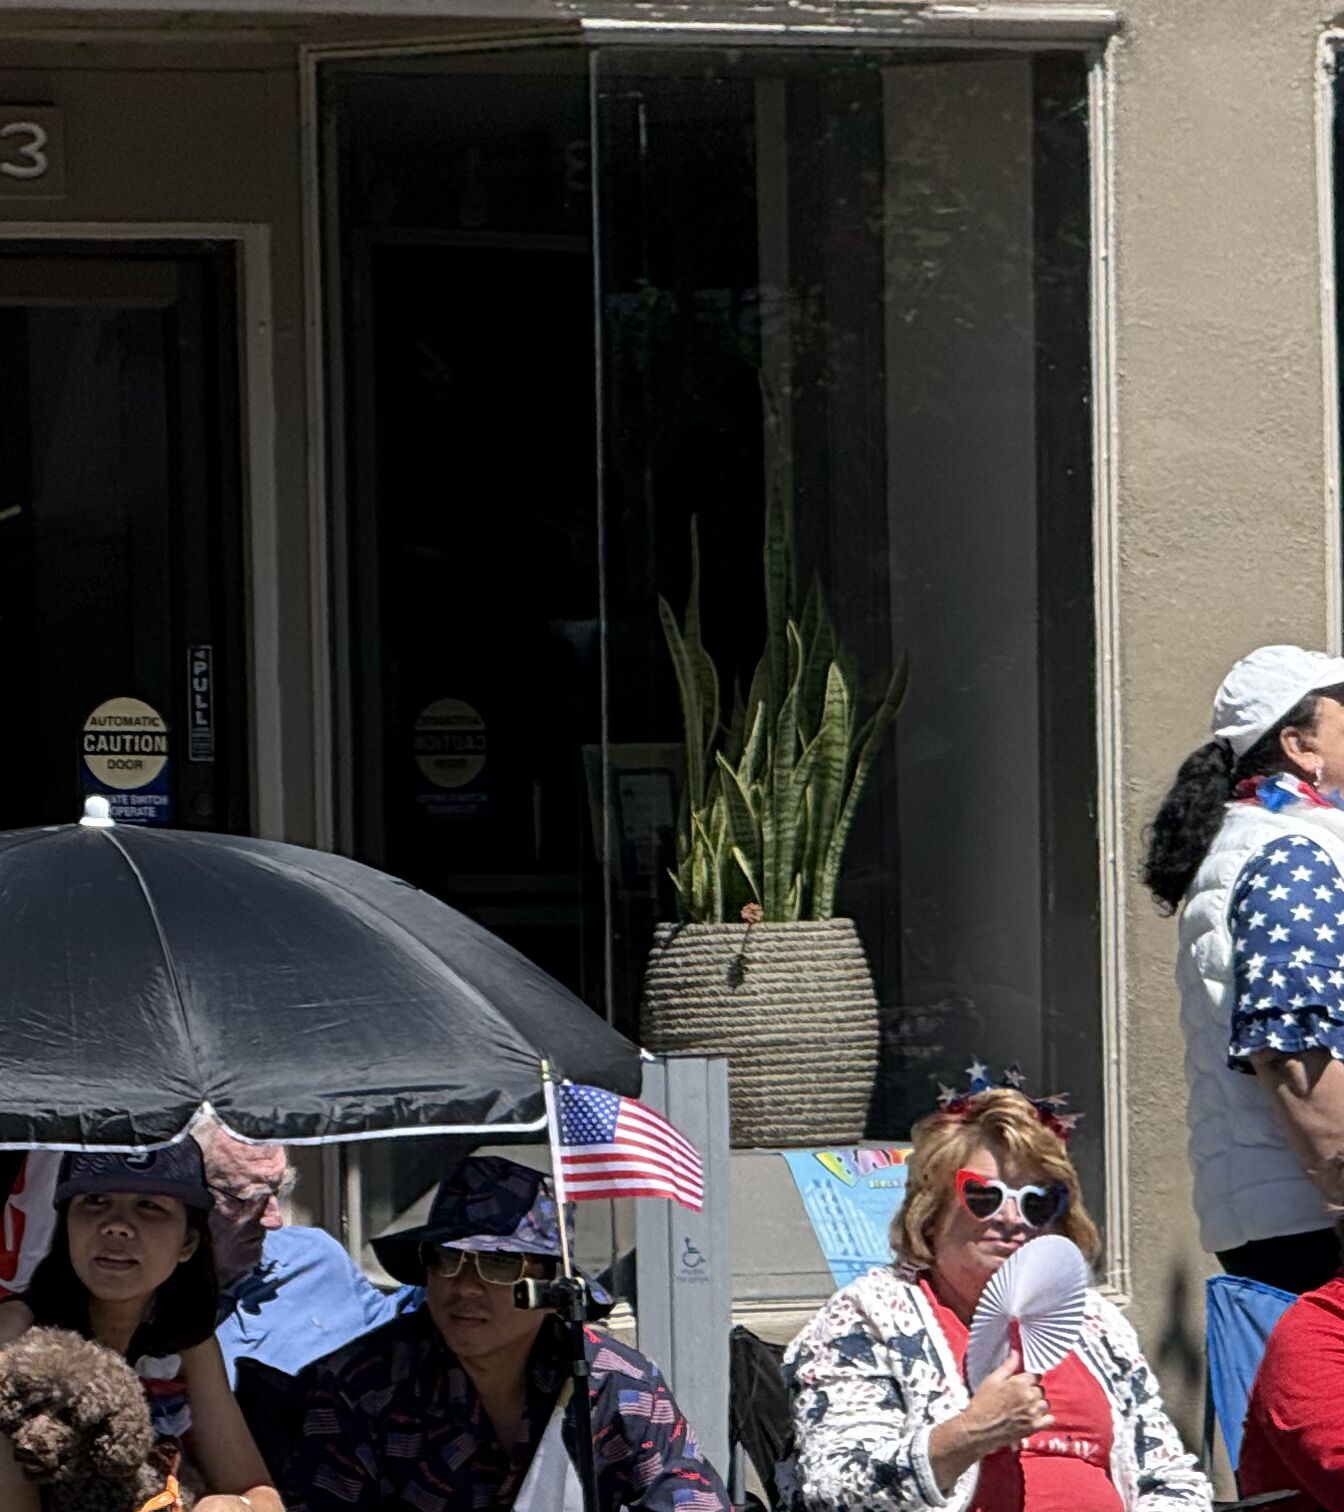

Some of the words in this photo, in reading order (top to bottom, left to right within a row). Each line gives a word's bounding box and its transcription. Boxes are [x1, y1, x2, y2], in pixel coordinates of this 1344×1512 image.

[0, 122, 47, 178] 3
[193, 660, 209, 726] PULL
[90, 716, 160, 726] AUTOMATIC
[83, 734, 167, 752] CAUTION
[106, 759, 144, 769] DOOR
